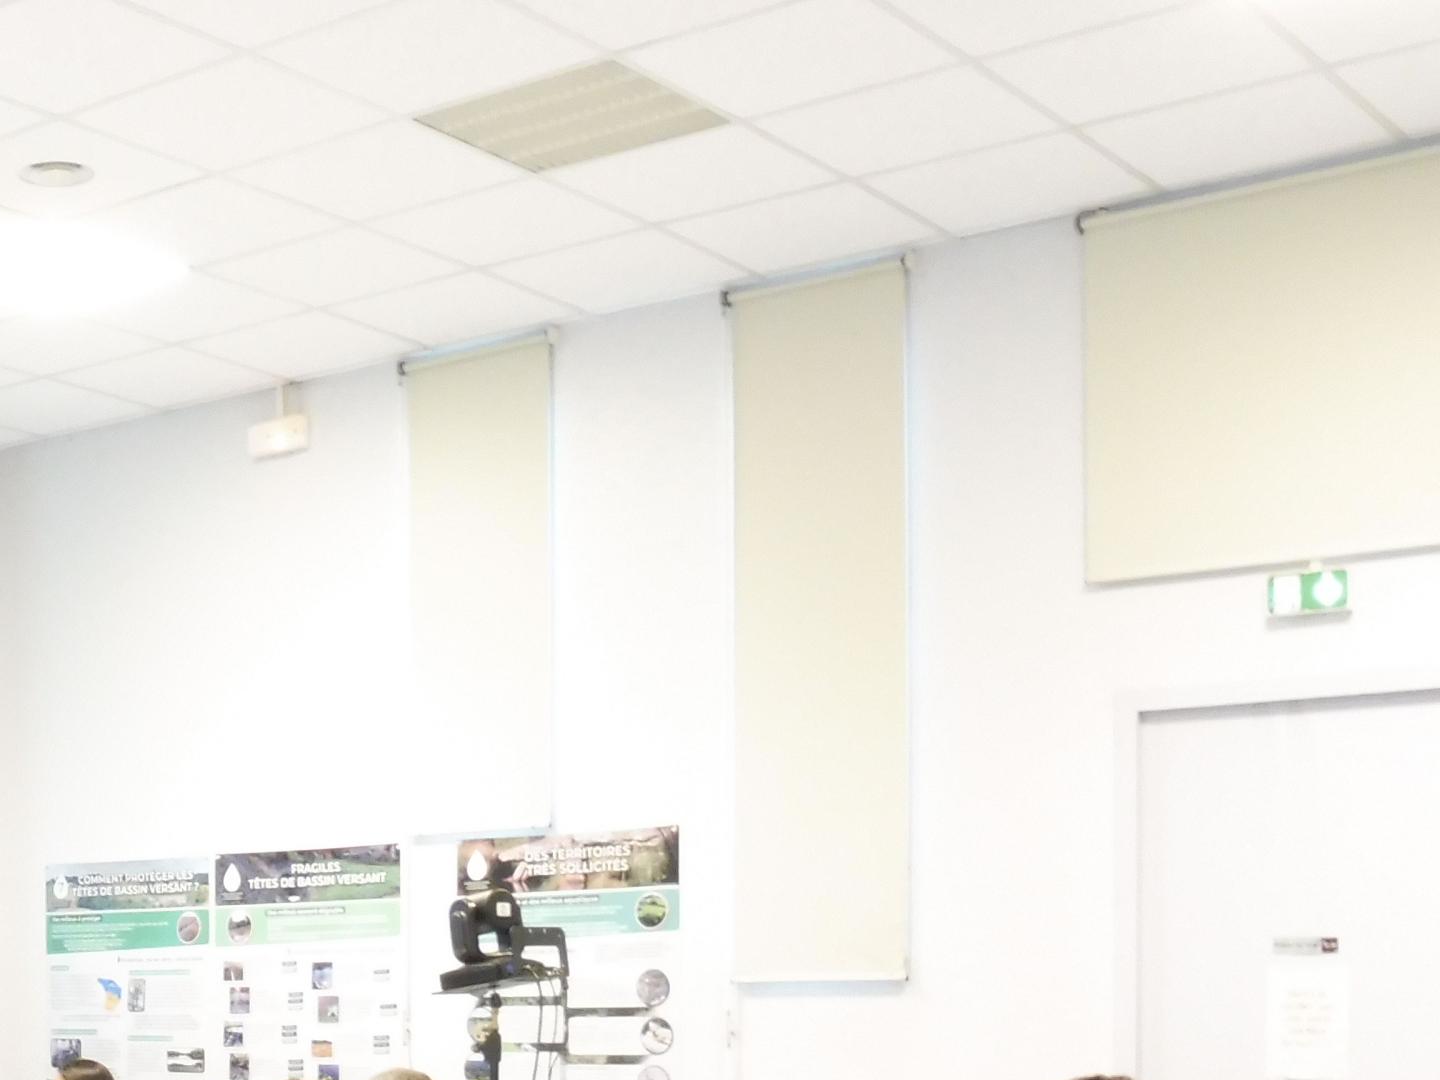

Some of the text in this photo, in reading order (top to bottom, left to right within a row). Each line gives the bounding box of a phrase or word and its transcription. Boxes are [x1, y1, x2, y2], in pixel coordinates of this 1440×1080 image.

[552, 846, 631, 860] TERRITOIRES
[291, 862, 341, 874] FRAGILES
[77, 874, 123, 885] COMMENT
[175, 870, 194, 881] LES
[280, 877, 296, 888] DE
[297, 875, 337, 887] BASSIN
[338, 872, 386, 885] VERSANT
[100, 885, 112, 896] DE
[115, 883, 148, 895] BASSIN
[149, 881, 191, 894] VERSANT
